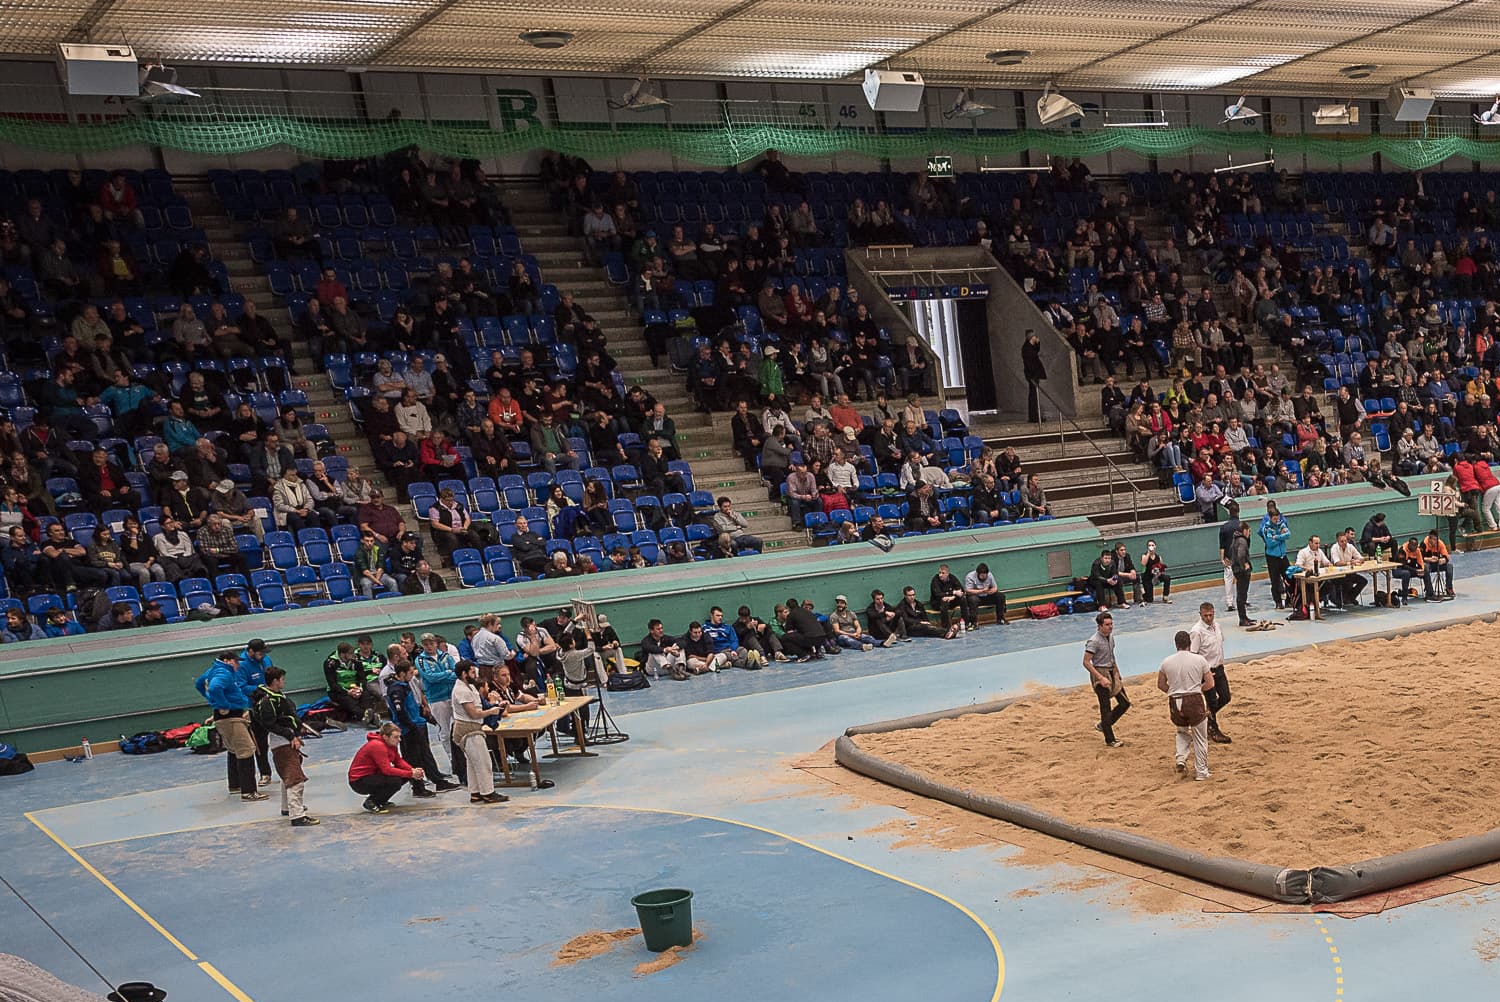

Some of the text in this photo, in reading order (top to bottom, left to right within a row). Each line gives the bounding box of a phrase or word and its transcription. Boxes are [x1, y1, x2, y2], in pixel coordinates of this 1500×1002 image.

[798, 103, 817, 117] 45
[839, 105, 858, 119] 46
[961, 287, 969, 296] D
[1434, 482, 1440, 492] 2
[1421, 496, 1452, 510] 132
